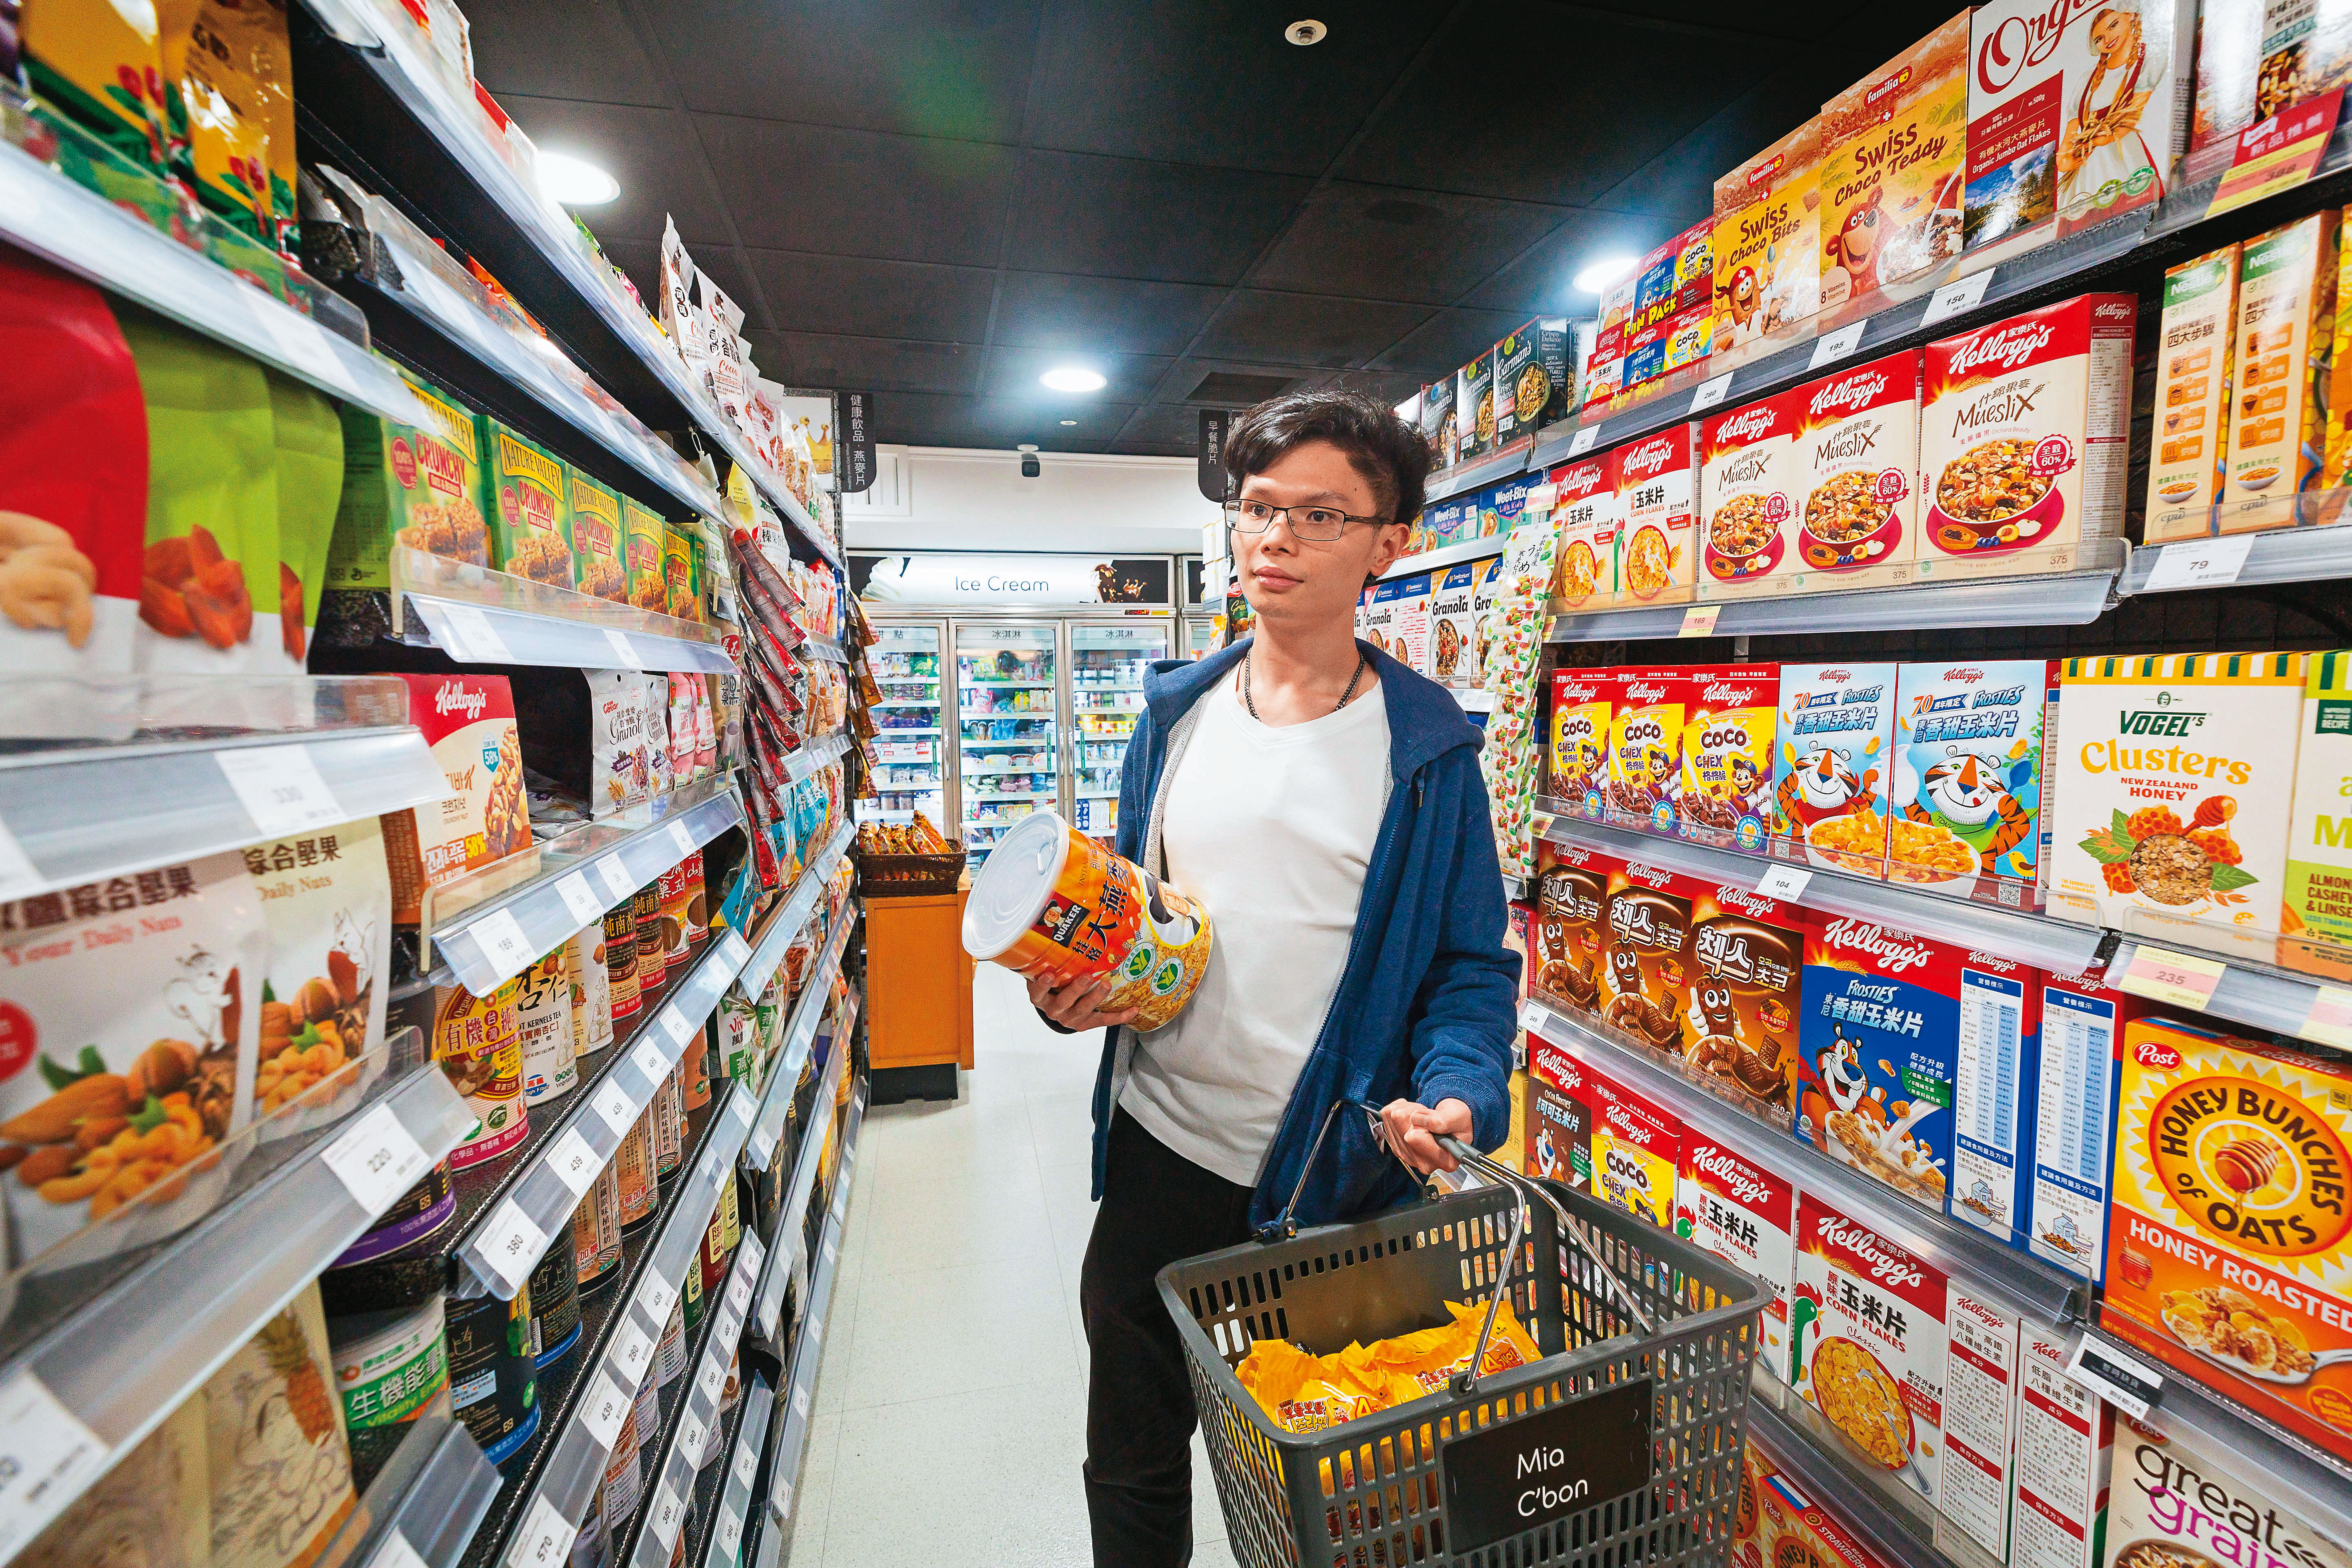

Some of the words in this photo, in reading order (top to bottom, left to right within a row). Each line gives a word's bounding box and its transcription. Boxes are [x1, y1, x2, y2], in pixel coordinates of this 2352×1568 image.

[1867, 78, 1898, 105] familia
[1855, 123, 1918, 174] Swiss
[1979, 118, 2045, 160] 有機冰河大燕麥片
[1973, 157, 1994, 174] Organic
[1996, 146, 2016, 162] Jumbo
[2017, 140, 2027, 150] Oat
[2029, 128, 2051, 145] Flakes
[1750, 163, 1774, 184] familia
[1835, 170, 1881, 207] Choco
[1887, 135, 1949, 177] Teddy
[1740, 203, 1788, 244] Swiss
[1730, 236, 1766, 267] Choco
[1771, 218, 1800, 244] Bits
[1821, 291, 1826, 305] 8
[1828, 283, 1846, 294] Vitamins
[1827, 289, 1846, 301] Vitamine
[1947, 294, 1965, 306] 150
[1624, 315, 1646, 338] FUN
[1648, 296, 1677, 327] PACK
[2007, 322, 2037, 338] 家樂氏
[1829, 341, 1844, 352] 195
[1949, 325, 2055, 375] Kellogg's
[1496, 340, 1532, 380] Carman's
[1853, 370, 1877, 384] 家樂氏
[1704, 390, 1717, 399] 280
[1810, 374, 1889, 414] Kellogg's
[1978, 379, 2031, 408] 什錦果麥
[1716, 409, 1777, 444] Kellogg's
[1833, 420, 1872, 442] 什錦果麥
[1207, 419, 1218, 466] 早餐脆片
[2042, 445, 2061, 455] 全穀
[415, 432, 466, 487] CRUNCHY
[501, 437, 534, 472] NATURE
[533, 455, 563, 495] VALLEY
[1623, 442, 1674, 476] Kellogg's
[2042, 456, 2061, 467] 60%
[1561, 466, 1604, 496] Kellogg's
[1882, 476, 1897, 486] 全穀
[1882, 486, 1898, 495] 60%
[519, 480, 556, 523] CRUNCHY
[573, 480, 596, 508] NATURE
[595, 493, 619, 523] VALLEY
[1495, 486, 1527, 505] Weet-Bix
[1636, 486, 1664, 509] 玉米片
[1434, 506, 1460, 523] Weet-Bix
[1570, 504, 1593, 526] 玉米片
[1630, 510, 1644, 518] CORN
[1646, 504, 1665, 514] FLAKES
[1770, 508, 1782, 516] 60%
[586, 515, 615, 549] CRUNCHY
[628, 508, 646, 533] NATURE
[645, 518, 664, 542] VALLEY
[637, 536, 660, 564] CRUNCHY
[2050, 555, 2068, 566] 375
[1453, 571, 1471, 582] Sanitarium
[1893, 570, 1907, 579] 375
[2190, 561, 2208, 570] 79
[955, 576, 980, 592] Ice
[987, 576, 1049, 592] Cream
[1432, 595, 1469, 616] Granola
[1366, 608, 1392, 627] Granola
[1692, 673, 1716, 684] 家樂氏
[435, 680, 487, 720] Kellogg's
[1563, 682, 1599, 699] Kellogg's
[1626, 681, 1669, 704] Kellogg's
[1703, 682, 1757, 706] Kellogg's
[1842, 685, 1884, 705] FROSTIES
[1972, 686, 2025, 710] FROSTIES
[1791, 692, 1811, 713] 70
[1910, 695, 1934, 718] 70
[1933, 696, 1962, 710] 週年限定
[1561, 719, 1592, 736] COCO
[1624, 723, 1661, 741] COCO
[1803, 706, 1878, 735] 香甜玉米片
[1925, 710, 2020, 742] 香甜玉米片
[2120, 710, 2207, 737] VOGEL'S
[1557, 742, 1576, 755] CHEX
[1701, 729, 1747, 748] COCO
[483, 750, 499, 766] 58%
[1619, 746, 1643, 761] CHEX
[1695, 754, 1724, 770] CHEX
[2080, 738, 2252, 786] Clusters
[1625, 760, 1645, 771] 格格脆
[1702, 770, 1727, 782] 格格脆
[2120, 777, 2145, 786] NEW
[2146, 780, 2198, 791] ZEALAND
[2129, 787, 2187, 802] HONEY
[1937, 815, 1956, 830] TONY
[1626, 861, 1673, 889] Kellogg's
[1717, 885, 1777, 915] Kellogg's
[1053, 904, 1082, 942] QUAKER
[499, 938, 513, 951] 189
[1072, 939, 1104, 962] 桂格
[1655, 932, 1682, 953] 초코
[1824, 917, 1935, 973] Kellogg's
[1754, 971, 1788, 993] 초코
[1978, 976, 2005, 990] 營養標示
[2156, 971, 2185, 984] 235
[1846, 979, 1899, 1005] FROSTIES
[2062, 996, 2094, 1011] 營養標示
[1831, 997, 1924, 1039] 香甜玉米片
[443, 1017, 484, 1054] 有機
[648, 1057, 657, 1068] 499
[1910, 1052, 1945, 1071] 配方升級
[2138, 1044, 2178, 1065] Post
[1536, 1047, 1583, 1090] Kellogg's
[1909, 1061, 1943, 1080] 健康成長
[613, 1102, 623, 1115] 439
[1540, 1099, 1580, 1133] 可可玉米片
[368, 1148, 391, 1173] 220
[1960, 1137, 2009, 1164] 建議食用量及方法
[2161, 1087, 2227, 1158] HONEY
[2236, 1087, 2346, 1216] BUNCHES
[570, 1156, 583, 1171] 439
[1606, 1152, 1648, 1189] COCO
[1601, 1174, 1627, 1200] CHEX
[1693, 1146, 1773, 1205] Kellogg's
[2040, 1168, 2097, 1197] 建議食用量及方法
[1708, 1200, 1759, 1248] 玉米片
[2207, 1202, 2317, 1245] OATS
[507, 1234, 523, 1255] 380
[1698, 1215, 1723, 1240] CORN
[1724, 1232, 1758, 1261] FLAKES
[1713, 1239, 1739, 1264] Classic
[1817, 1215, 1927, 1289] Kellogg's
[2130, 1218, 2217, 1271] HONEY
[2222, 1259, 2352, 1334] ROASTED
[1839, 1277, 1908, 1340] 玉米片
[1825, 1295, 1859, 1325] CORN
[1861, 1319, 1907, 1354] FLAKES
[1847, 1325, 1881, 1355] Classic
[1955, 1331, 2003, 1364] 八種維生素
[628, 1345, 639, 1362] 280
[1971, 1355, 1984, 1368] 成分
[1907, 1369, 1937, 1391] 配方升級
[602, 1402, 613, 1421] 439
[1516, 1444, 1565, 1480] Mia
[1959, 1445, 1984, 1469] 保存方法
[1517, 1477, 1589, 1517] C'bon
[2133, 1444, 2283, 1556] great
[663, 1506, 671, 1524] 380
[1763, 1497, 1782, 1522] Post
[537, 1536, 552, 1562] 570
